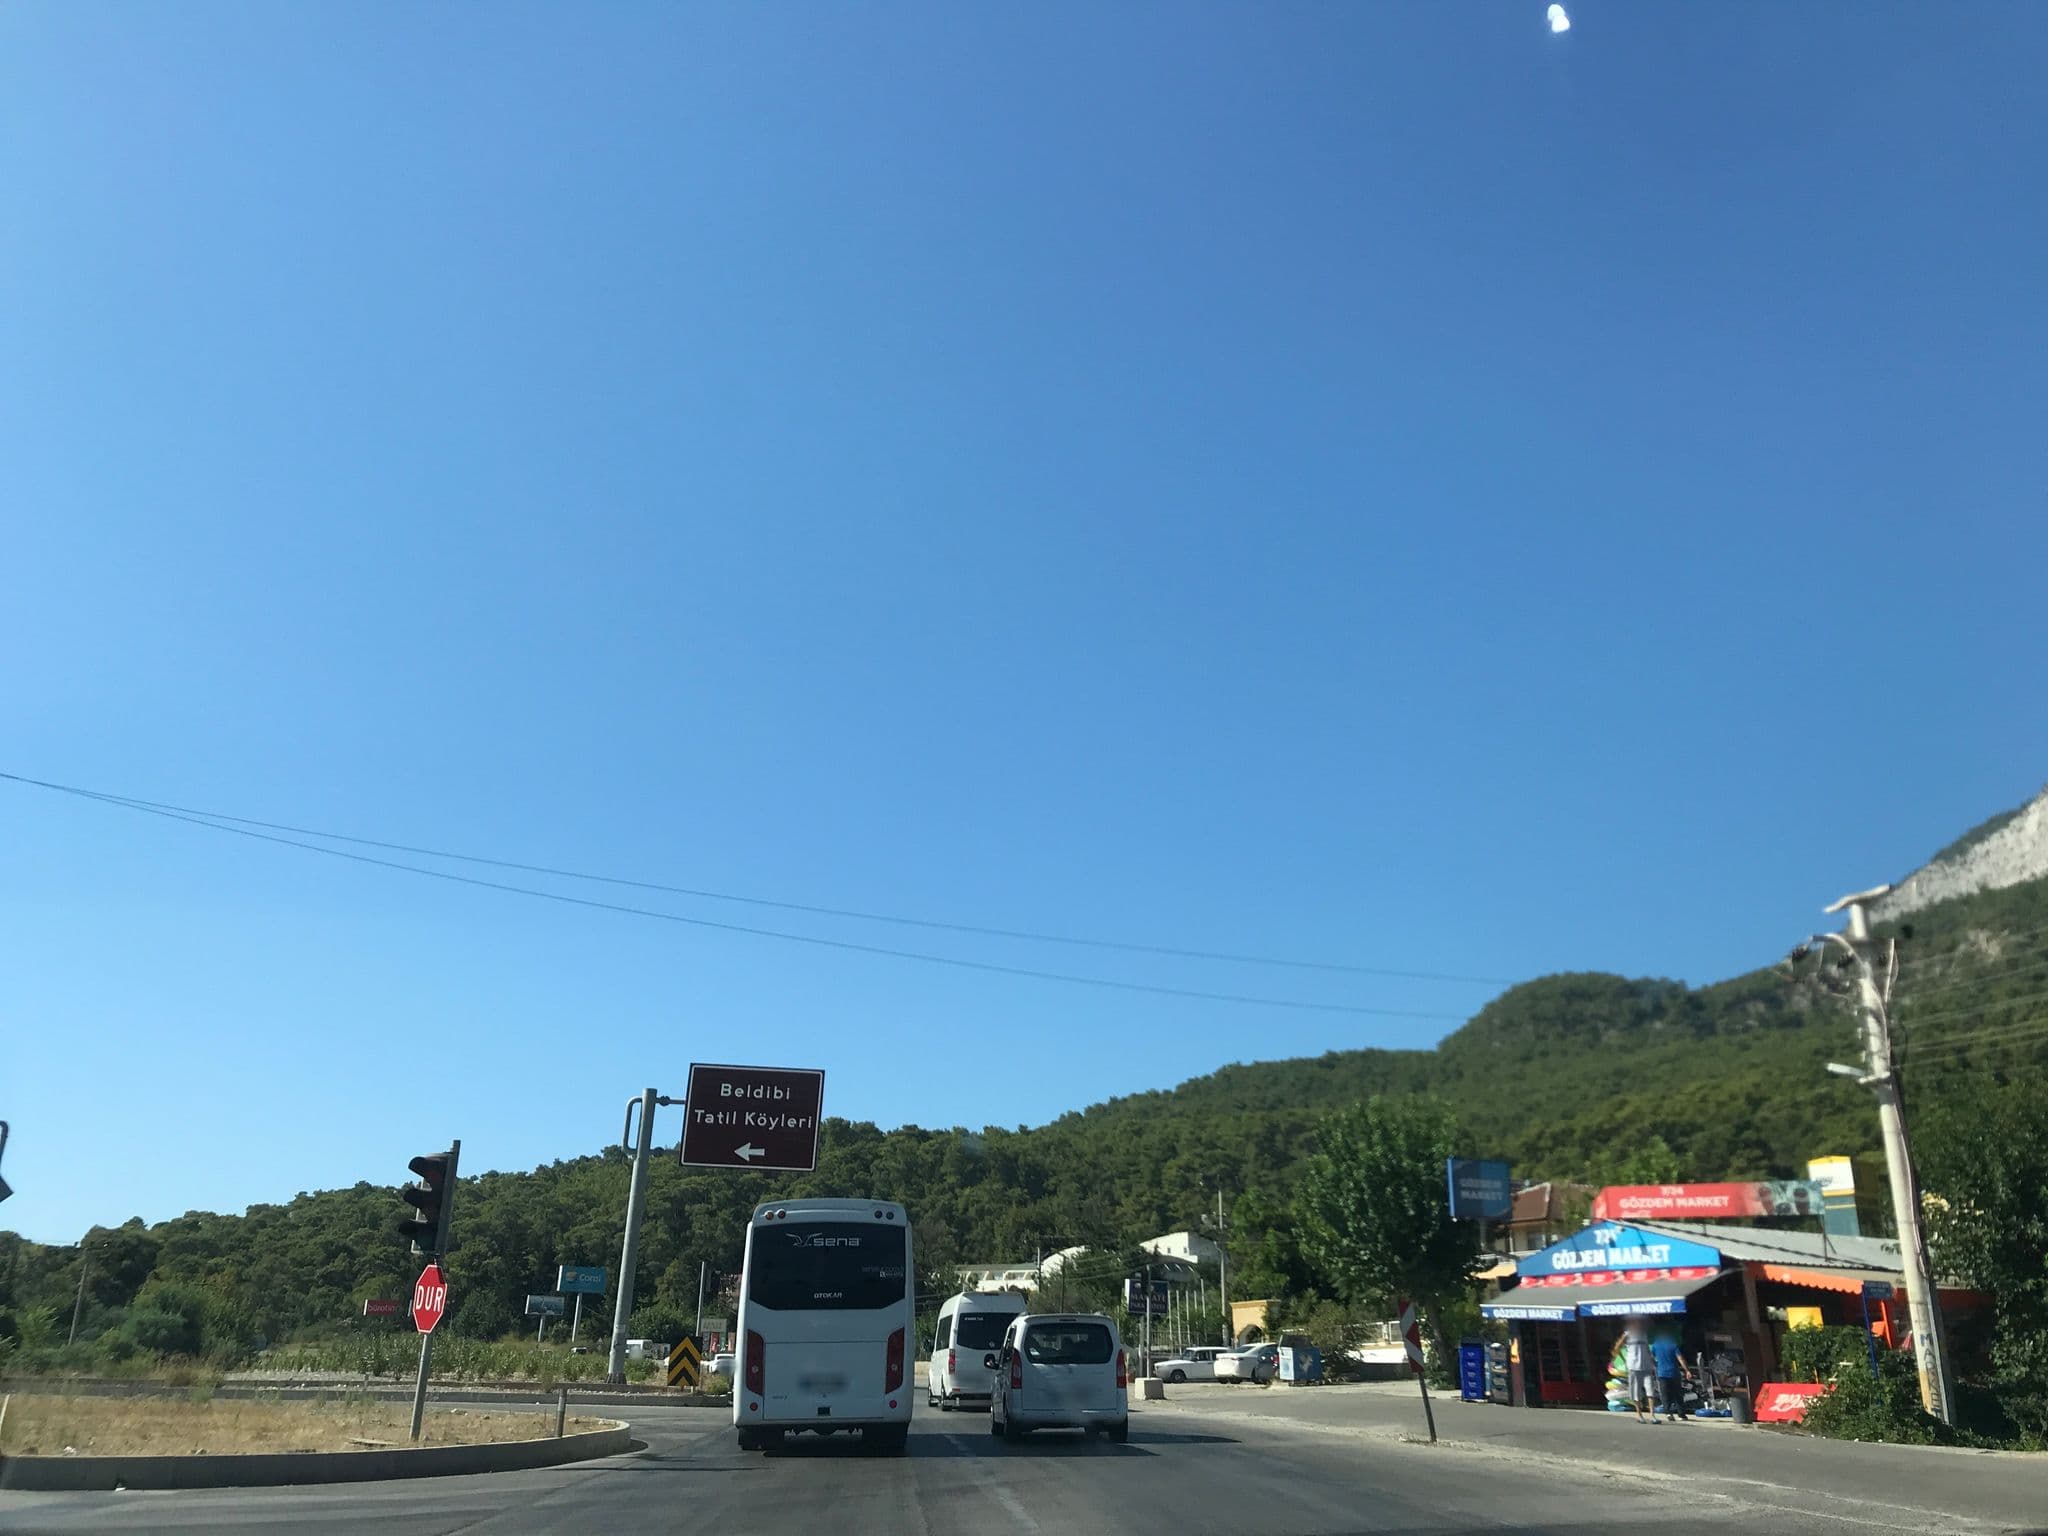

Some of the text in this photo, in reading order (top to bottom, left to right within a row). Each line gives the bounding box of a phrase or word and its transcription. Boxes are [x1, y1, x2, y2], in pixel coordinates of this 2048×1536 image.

[720, 1083, 790, 1100] Beldibi
[694, 1109, 812, 1130] Tatil Köyleri
[1619, 1196, 1729, 1209] GÖZDEM MARKET
[1608, 1244, 1671, 1266] MARKET
[416, 1285, 443, 1312] DUR
[1493, 1308, 1527, 1319] GÖZDEM
[1528, 1309, 1564, 1320] MARKET
[1591, 1302, 1672, 1316] GÖZDEM MARKET
